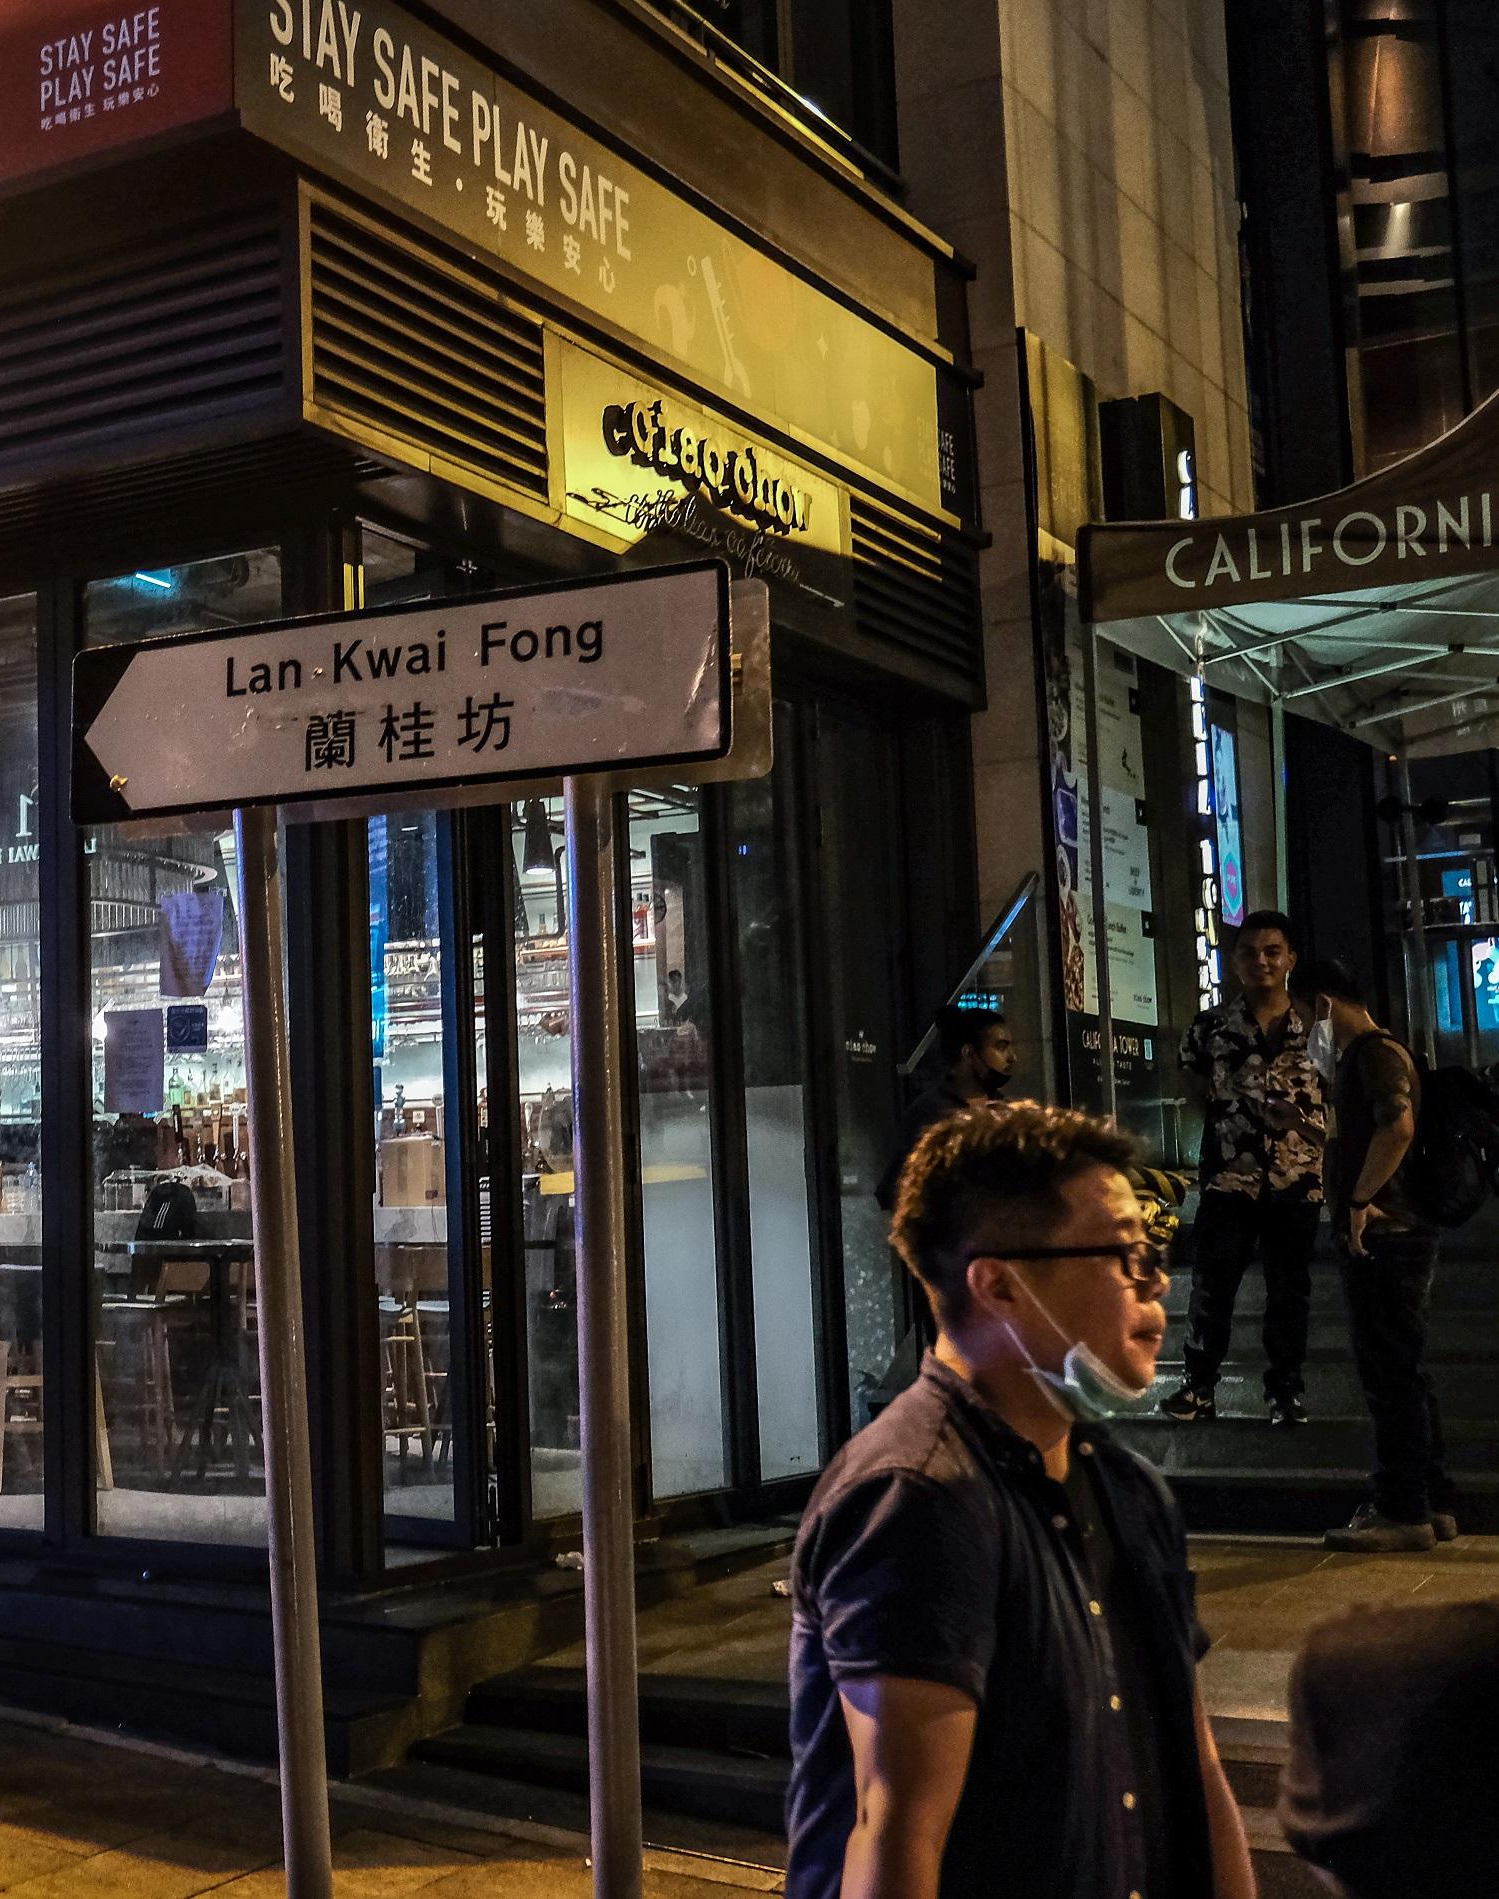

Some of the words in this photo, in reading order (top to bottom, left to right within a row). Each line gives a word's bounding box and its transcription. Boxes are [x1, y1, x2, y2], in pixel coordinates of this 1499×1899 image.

[40, 30, 94, 75] STAY
[102, 6, 160, 55] SAFE
[40, 64, 95, 112] PLAY
[103, 43, 160, 91] SAFE
[269, 0, 361, 88] STAY
[373, 27, 462, 155] SAFE
[471, 89, 549, 207] PLAY
[558, 151, 632, 261] SAFE
[1165, 492, 1492, 588] CALIFORNI
[225, 656, 303, 698] Lan
[332, 629, 447, 685] Kwai
[480, 618, 604, 668] Fong
[304, 692, 515, 772] 蘭桂坊
